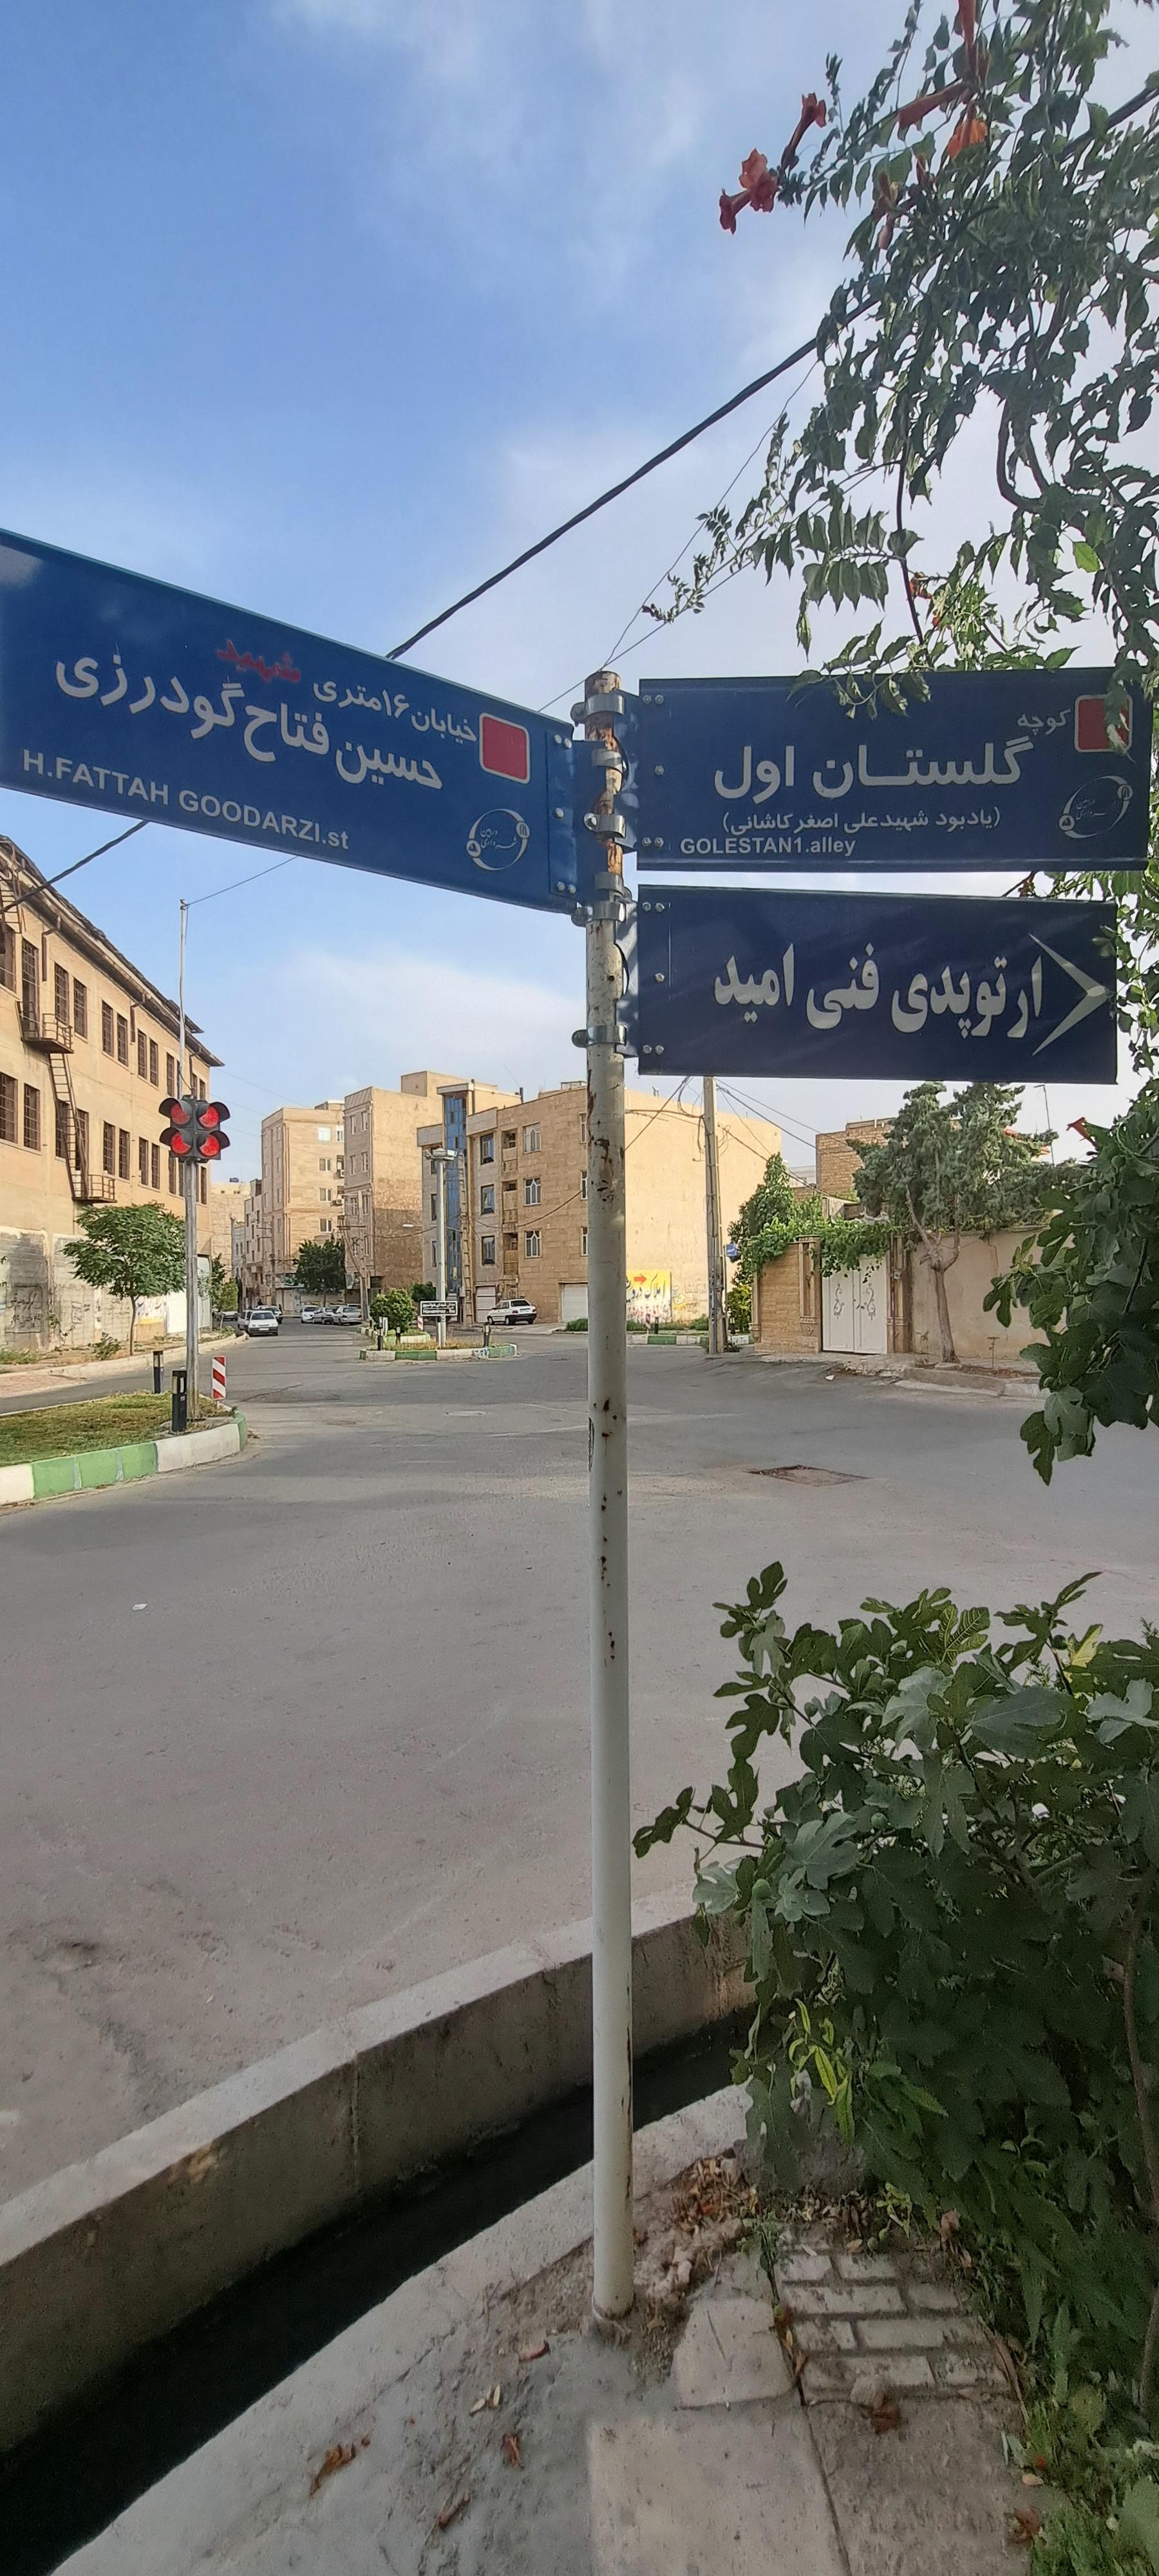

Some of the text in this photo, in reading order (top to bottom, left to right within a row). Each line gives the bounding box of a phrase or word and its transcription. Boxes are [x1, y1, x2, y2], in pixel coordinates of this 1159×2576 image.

[216, 639, 301, 684] شهید
[56, 653, 442, 790] حسین فتاح گودرزی
[411, 708, 477, 744] خیابان
[1017, 708, 1071, 735] کوچه
[714, 736, 1034, 804] گلستان اول
[23, 749, 349, 850] H.FATTAH GOODARZI.st
[793, 813, 838, 835] اصغر
[843, 812, 878, 834] علی
[880, 810, 929, 832] شهید
[680, 836, 856, 857] GOLESTAN1.alley
[713, 942, 1042, 1039] ارتوپدی فنی امید
